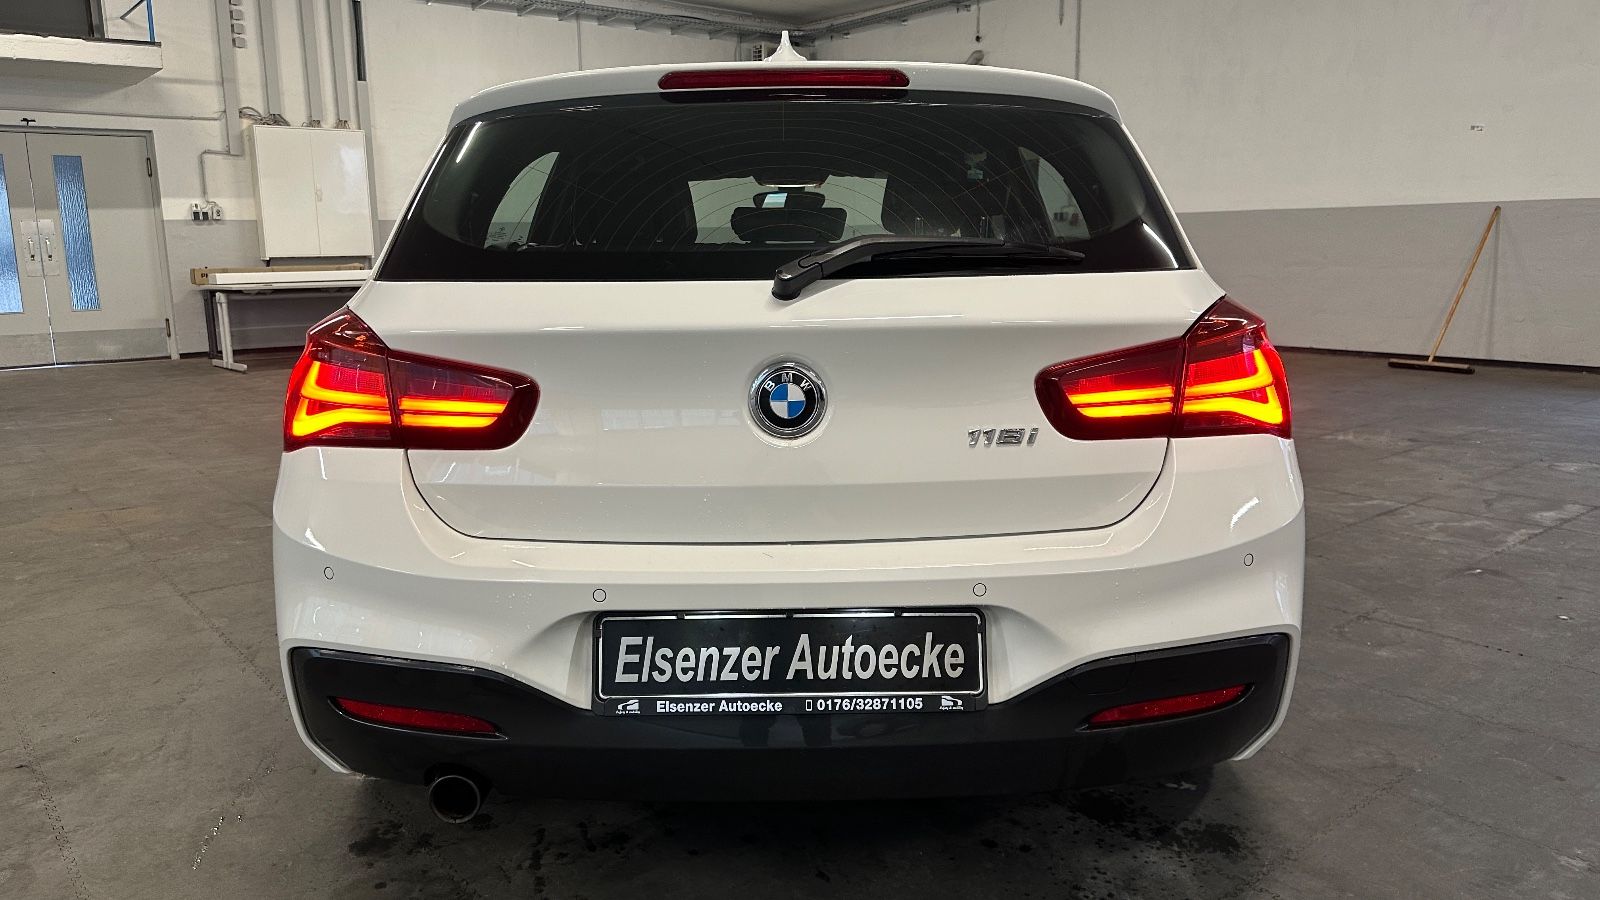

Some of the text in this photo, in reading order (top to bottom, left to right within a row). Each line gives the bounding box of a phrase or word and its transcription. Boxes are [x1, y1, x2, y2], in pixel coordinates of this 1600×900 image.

[763, 373, 812, 392] BMW
[967, 428, 1039, 446] 118i
[614, 631, 965, 683] Elsenzer Autoecke
[656, 700, 716, 713] Elsenzer
[718, 699, 783, 712] Autoecke
[816, 697, 923, 711] 0176/32871105
